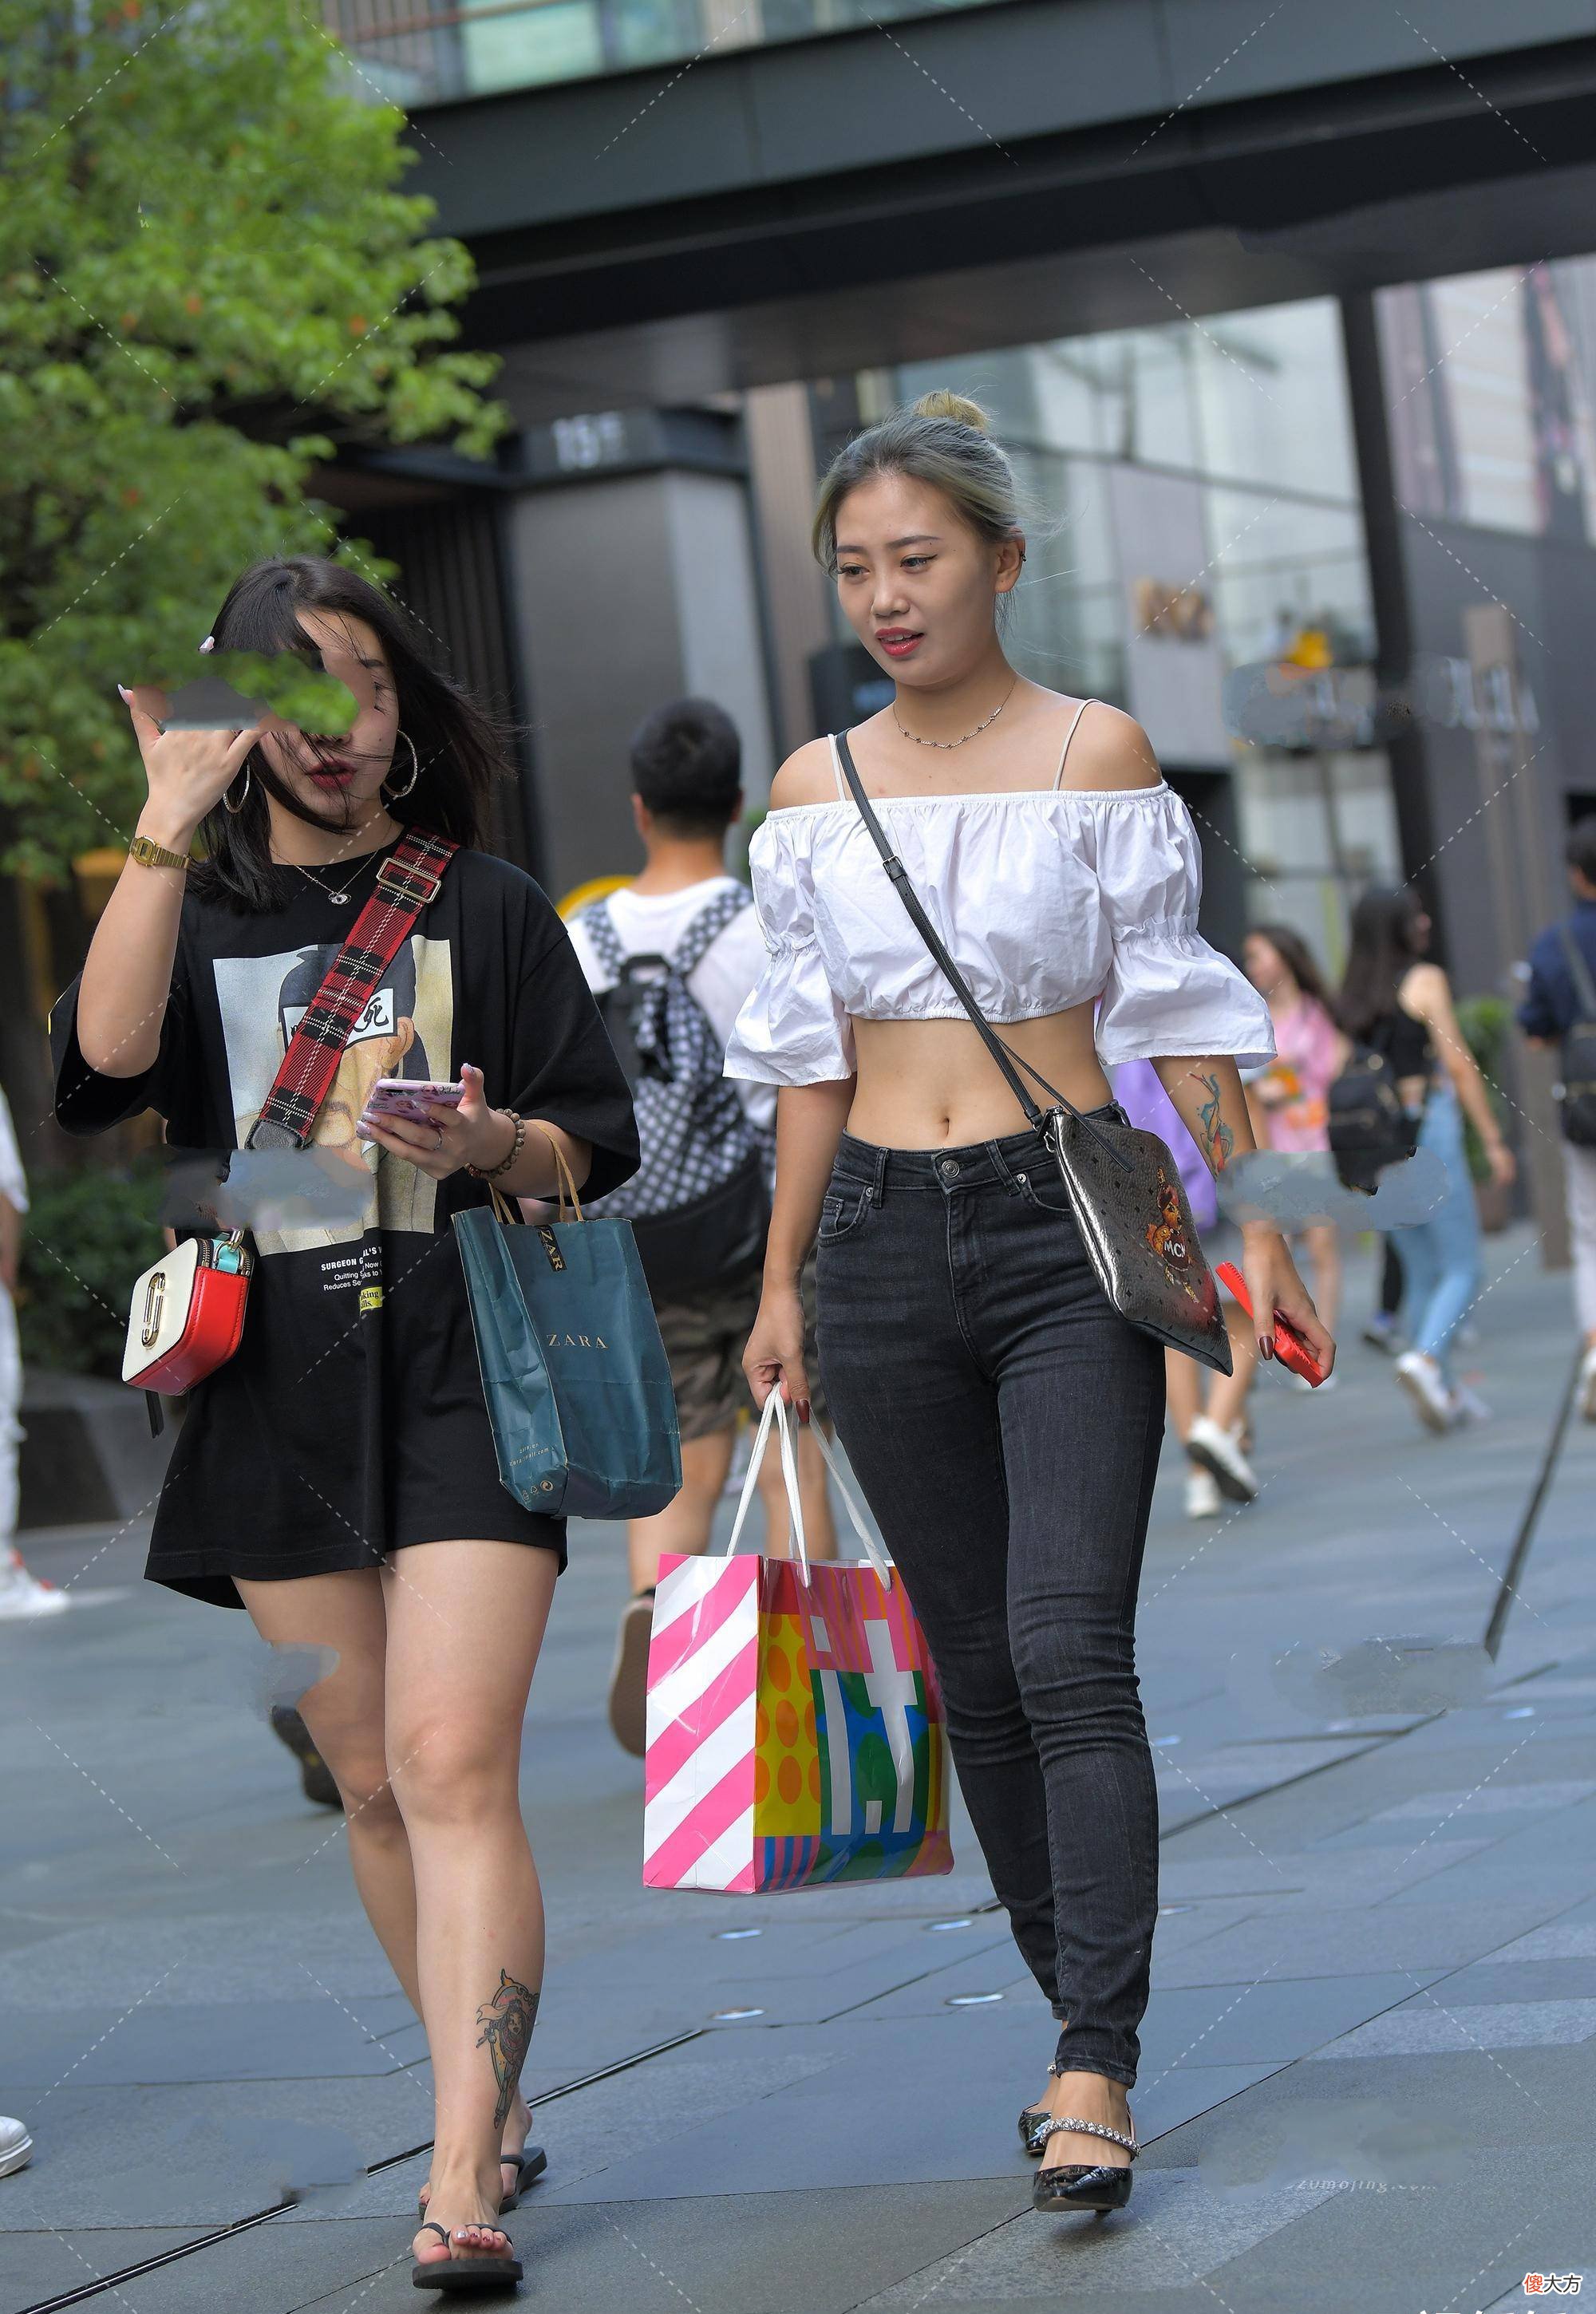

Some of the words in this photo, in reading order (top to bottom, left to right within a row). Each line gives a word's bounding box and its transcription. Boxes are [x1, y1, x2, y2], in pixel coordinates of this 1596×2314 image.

[321, 1258, 357, 1271] SURGEON
[334, 1272, 359, 1281] Quitting
[323, 1281, 351, 1291] Reduces
[546, 1333, 608, 1349] ZARA
